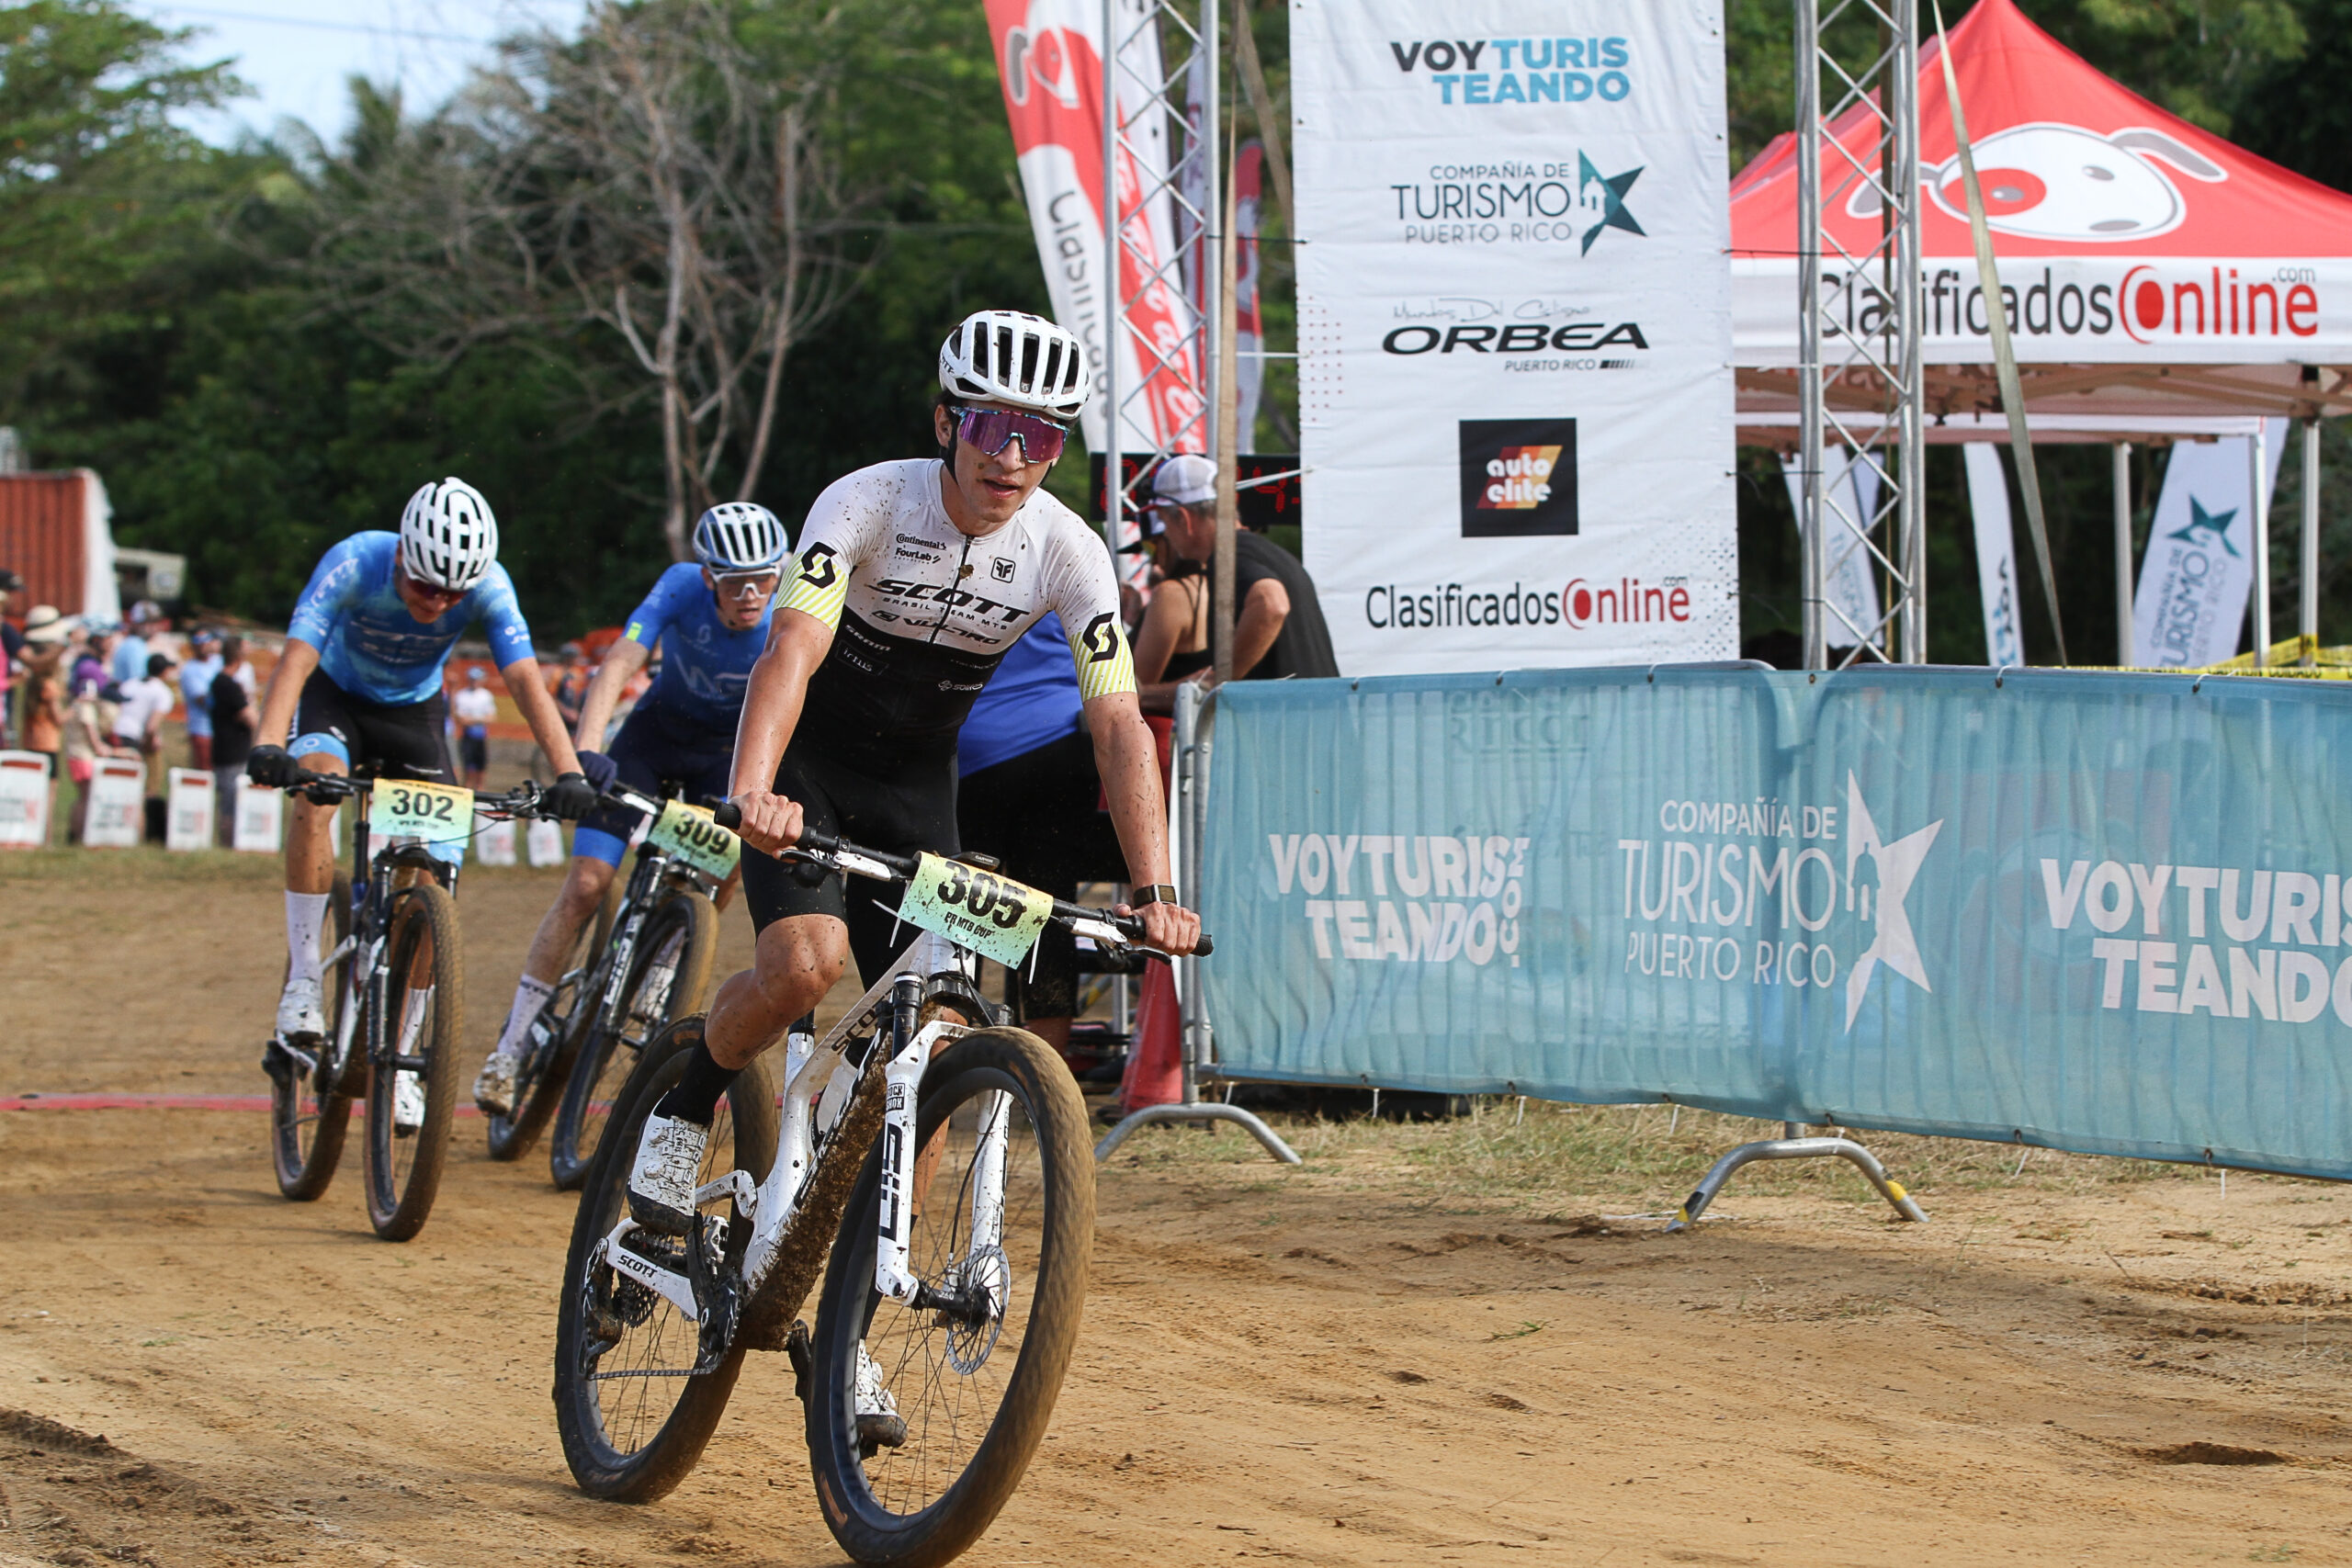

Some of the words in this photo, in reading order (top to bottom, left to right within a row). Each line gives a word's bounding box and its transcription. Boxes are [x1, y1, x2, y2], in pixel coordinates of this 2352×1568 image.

[1431, 70, 1631, 105] TEANDO
[1430, 160, 1536, 180] COMPAÑÍA
[1544, 163, 1570, 178] DE
[1390, 181, 1571, 220] TURISMO
[1406, 223, 1500, 243] PUERTO
[1510, 221, 1573, 243] RICO
[1382, 321, 1650, 355] ORBEA
[1503, 359, 1560, 372] PUERTO
[1562, 358, 1596, 370] RICO
[1486, 453, 1552, 477] auto
[1486, 479, 1553, 502] elite
[895, 547, 932, 561] FourLab
[896, 533, 940, 549] Continental
[868, 579, 1030, 623] SCOTT
[882, 597, 931, 610] BRASIL
[939, 606, 975, 621] TEAM
[981, 618, 1008, 630] MTB
[390, 788, 454, 822] 302
[1659, 796, 1795, 838] COMPAÑÍA
[1802, 805, 1838, 840] DE
[673, 811, 730, 855] 309
[937, 861, 1027, 929] 305
[1618, 838, 1837, 932] TURISMO
[944, 911, 958, 925] PR
[956, 916, 975, 932] MTB
[974, 924, 992, 939] CUP
[1305, 899, 1498, 966] TEANDO
[1623, 931, 1742, 982] PUERTO
[1752, 939, 1837, 989] RICO
[831, 986, 896, 1055] SCO
[887, 1086, 903, 1098] OCK
[616, 1254, 659, 1278] SCOTT
